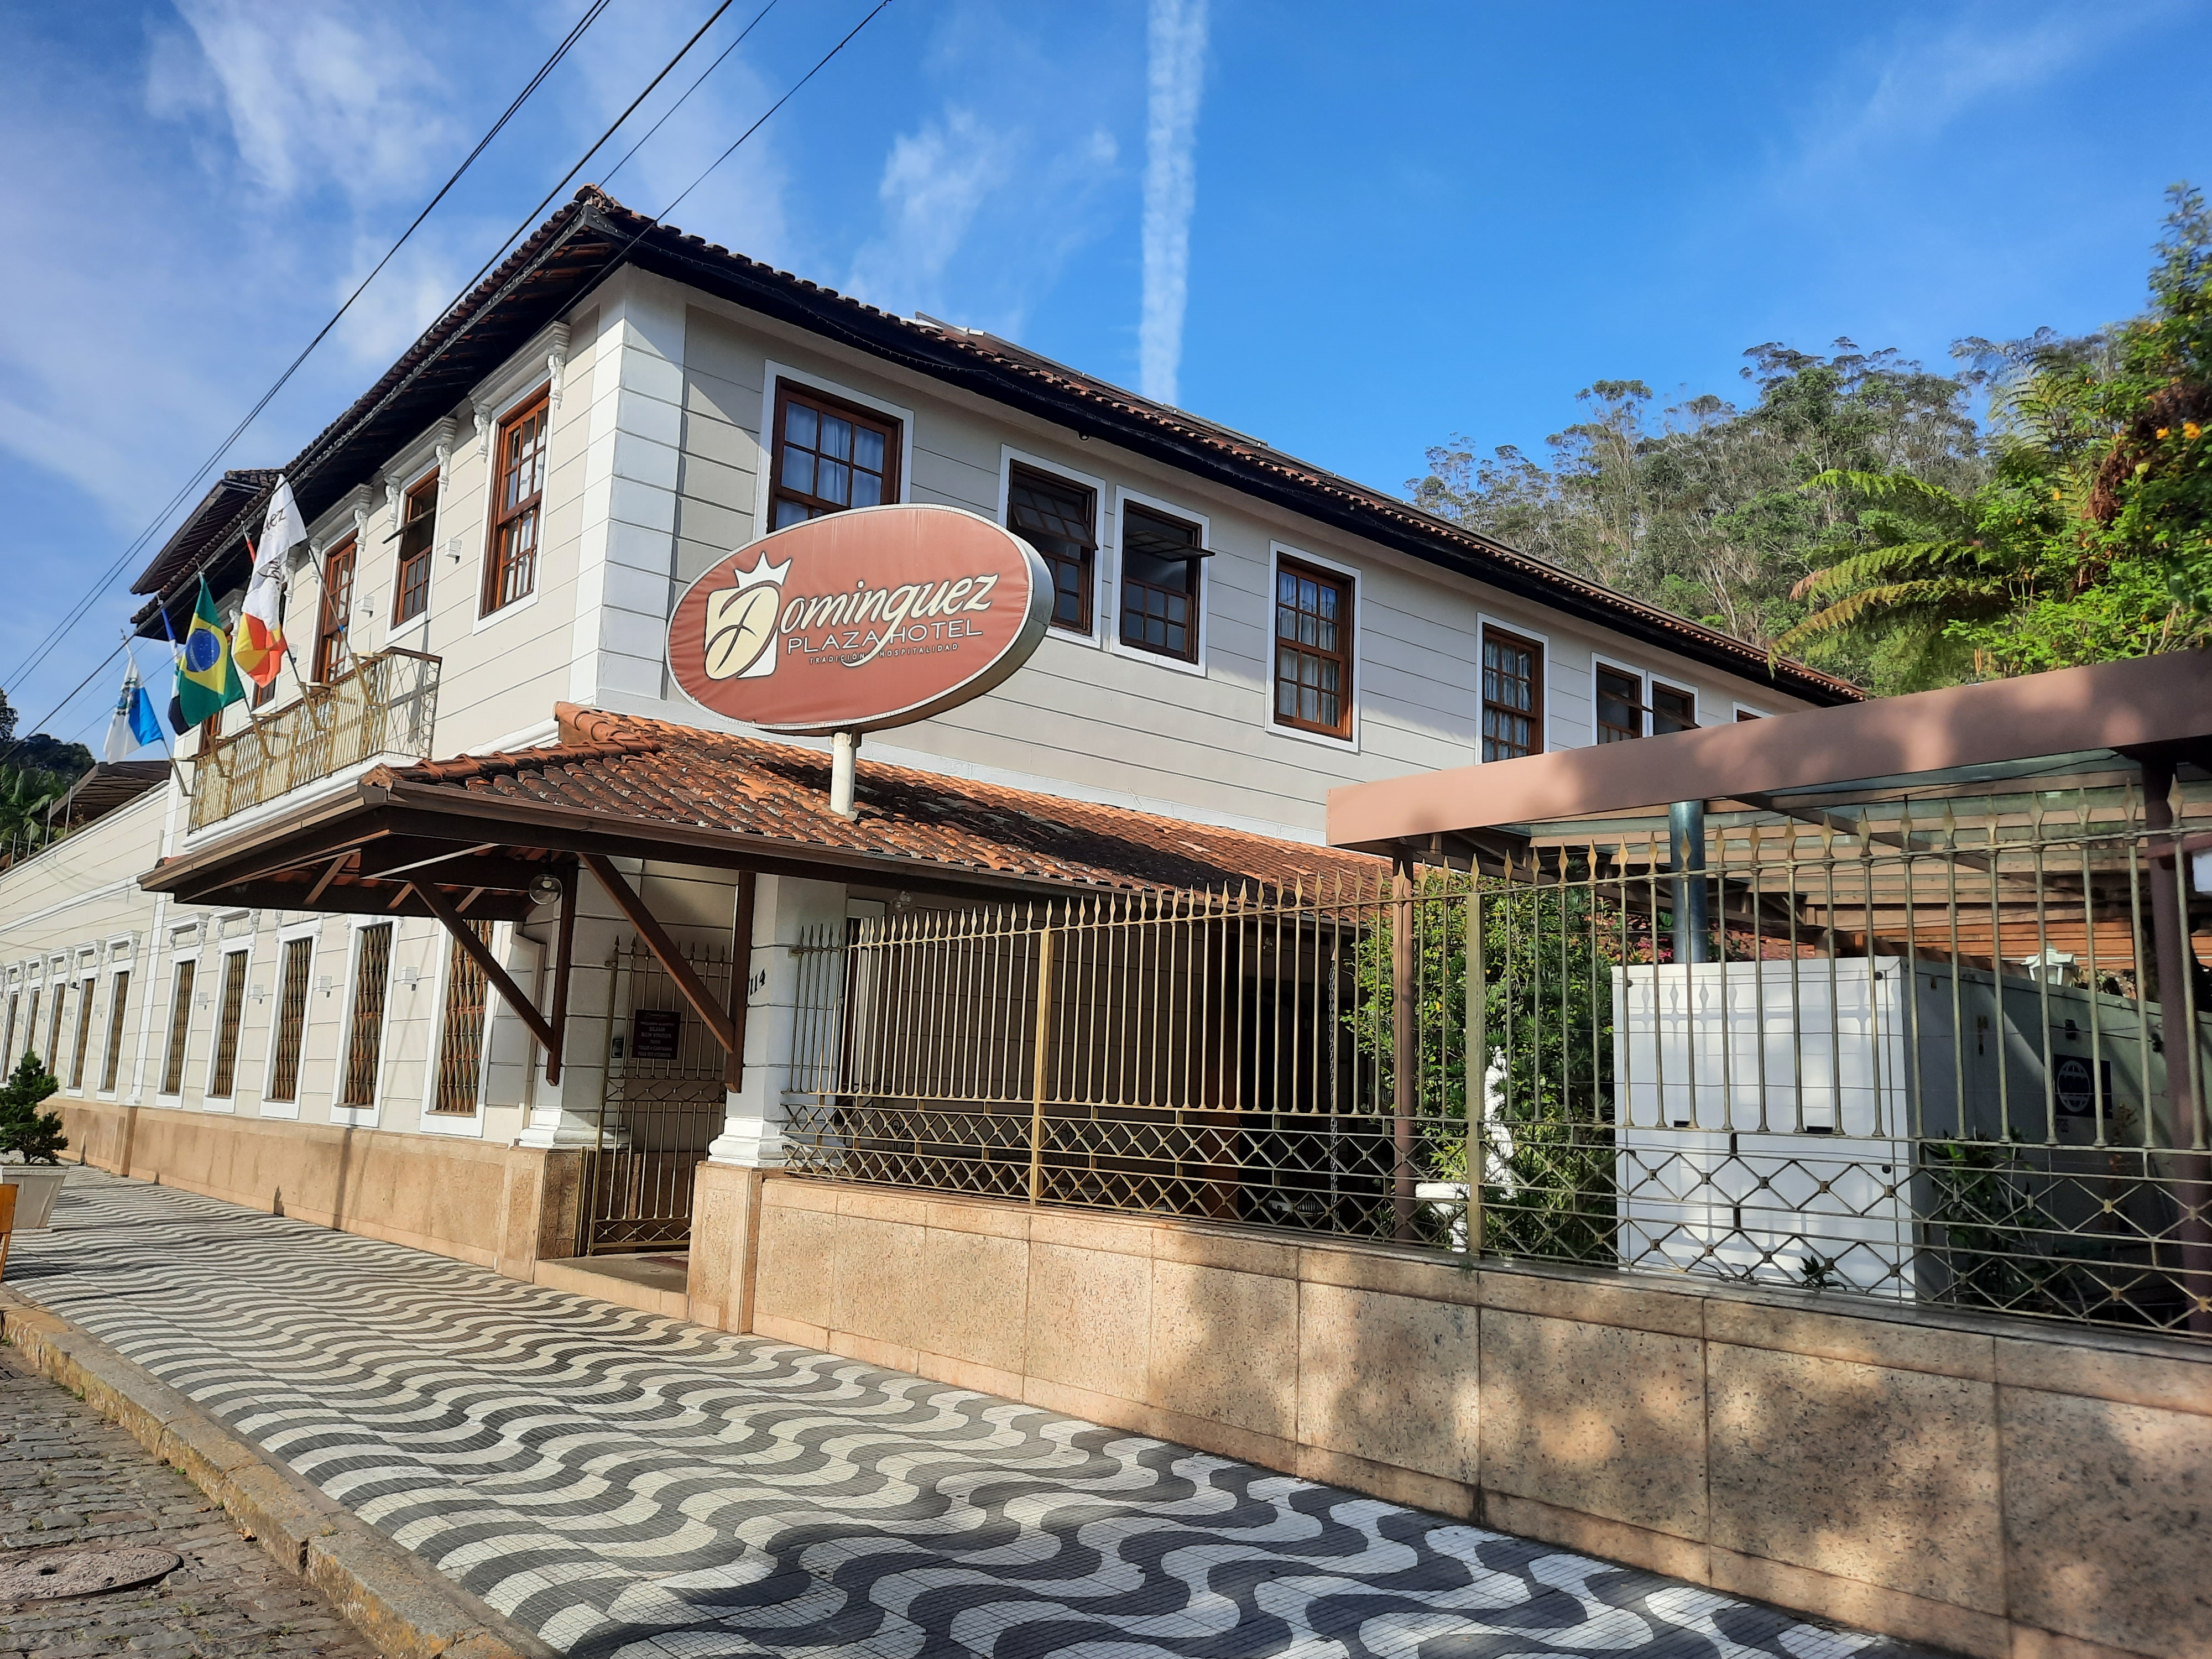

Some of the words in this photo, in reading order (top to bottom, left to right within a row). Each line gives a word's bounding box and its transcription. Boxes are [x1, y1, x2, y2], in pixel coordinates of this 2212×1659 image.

[787, 629, 881, 655] PLAZA
[889, 619, 983, 645] HOTEL
[879, 643, 958, 658] HOSPITALIDAD
[750, 968, 765, 997] 114
